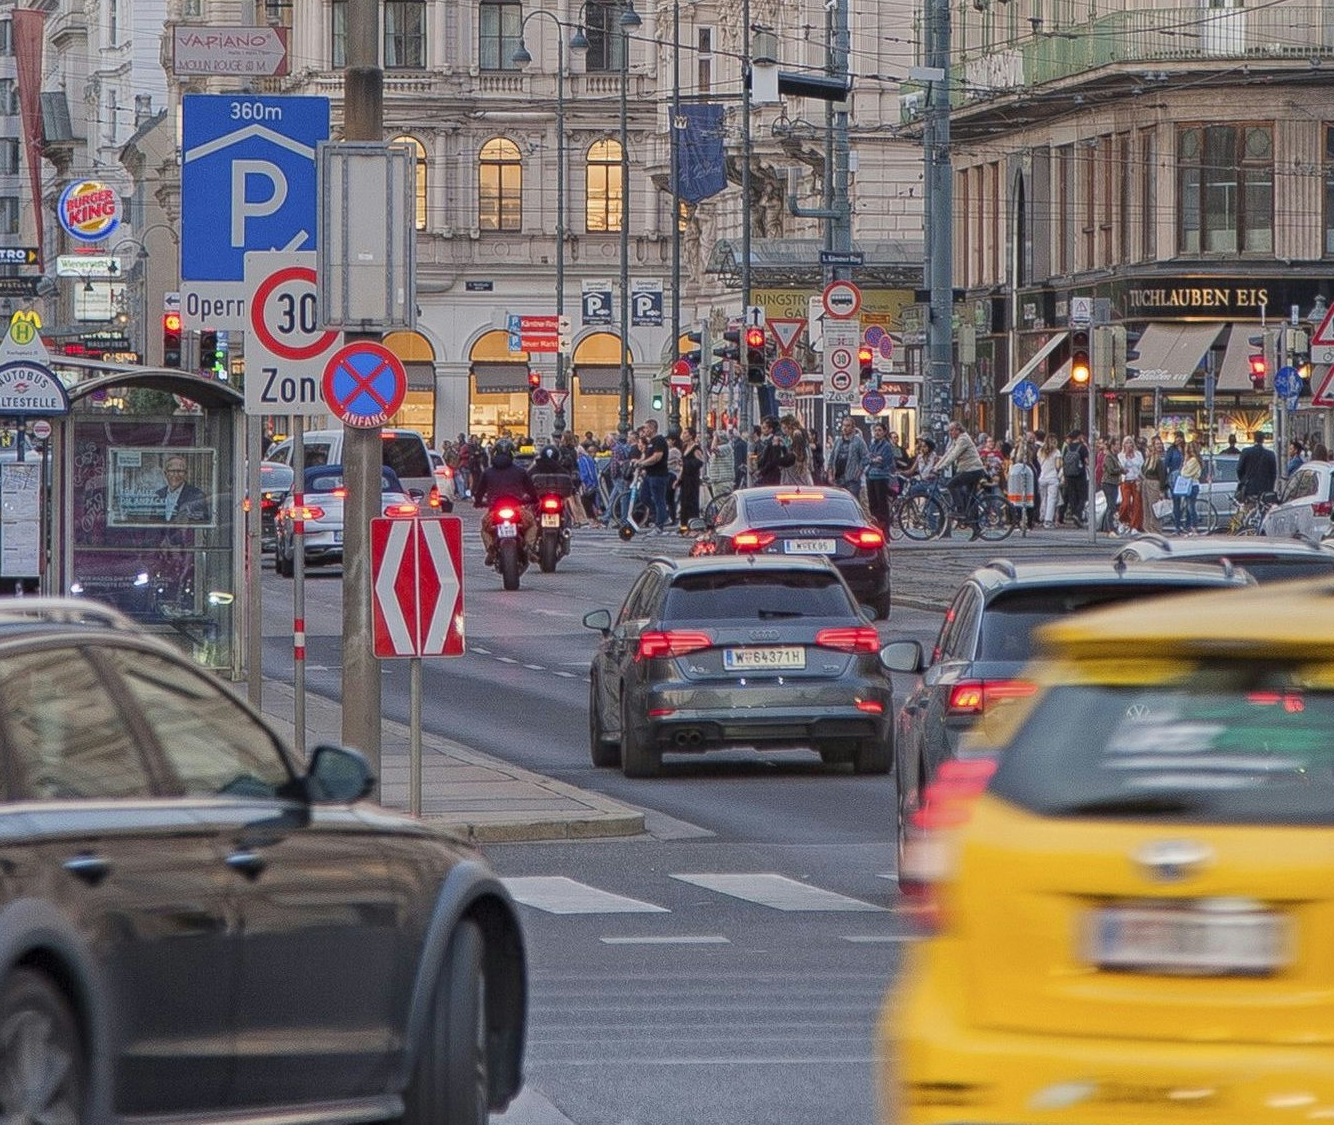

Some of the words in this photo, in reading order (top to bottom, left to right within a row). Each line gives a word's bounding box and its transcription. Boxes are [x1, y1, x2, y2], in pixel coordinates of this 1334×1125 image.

[177, 59, 211, 71] MOULIN
[214, 59, 243, 71] ROUGE
[230, 101, 283, 121] 360m
[67, 189, 114, 213] BURGER
[68, 200, 116, 228] KING
[1129, 288, 1230, 307] TUCHLAUBEN
[1236, 289, 1268, 306] EIS
[276, 292, 317, 334] 30
[260, 367, 325, 404] Zon
[341, 410, 389, 427] ANFANG
[735, 651, 744, 663] W
